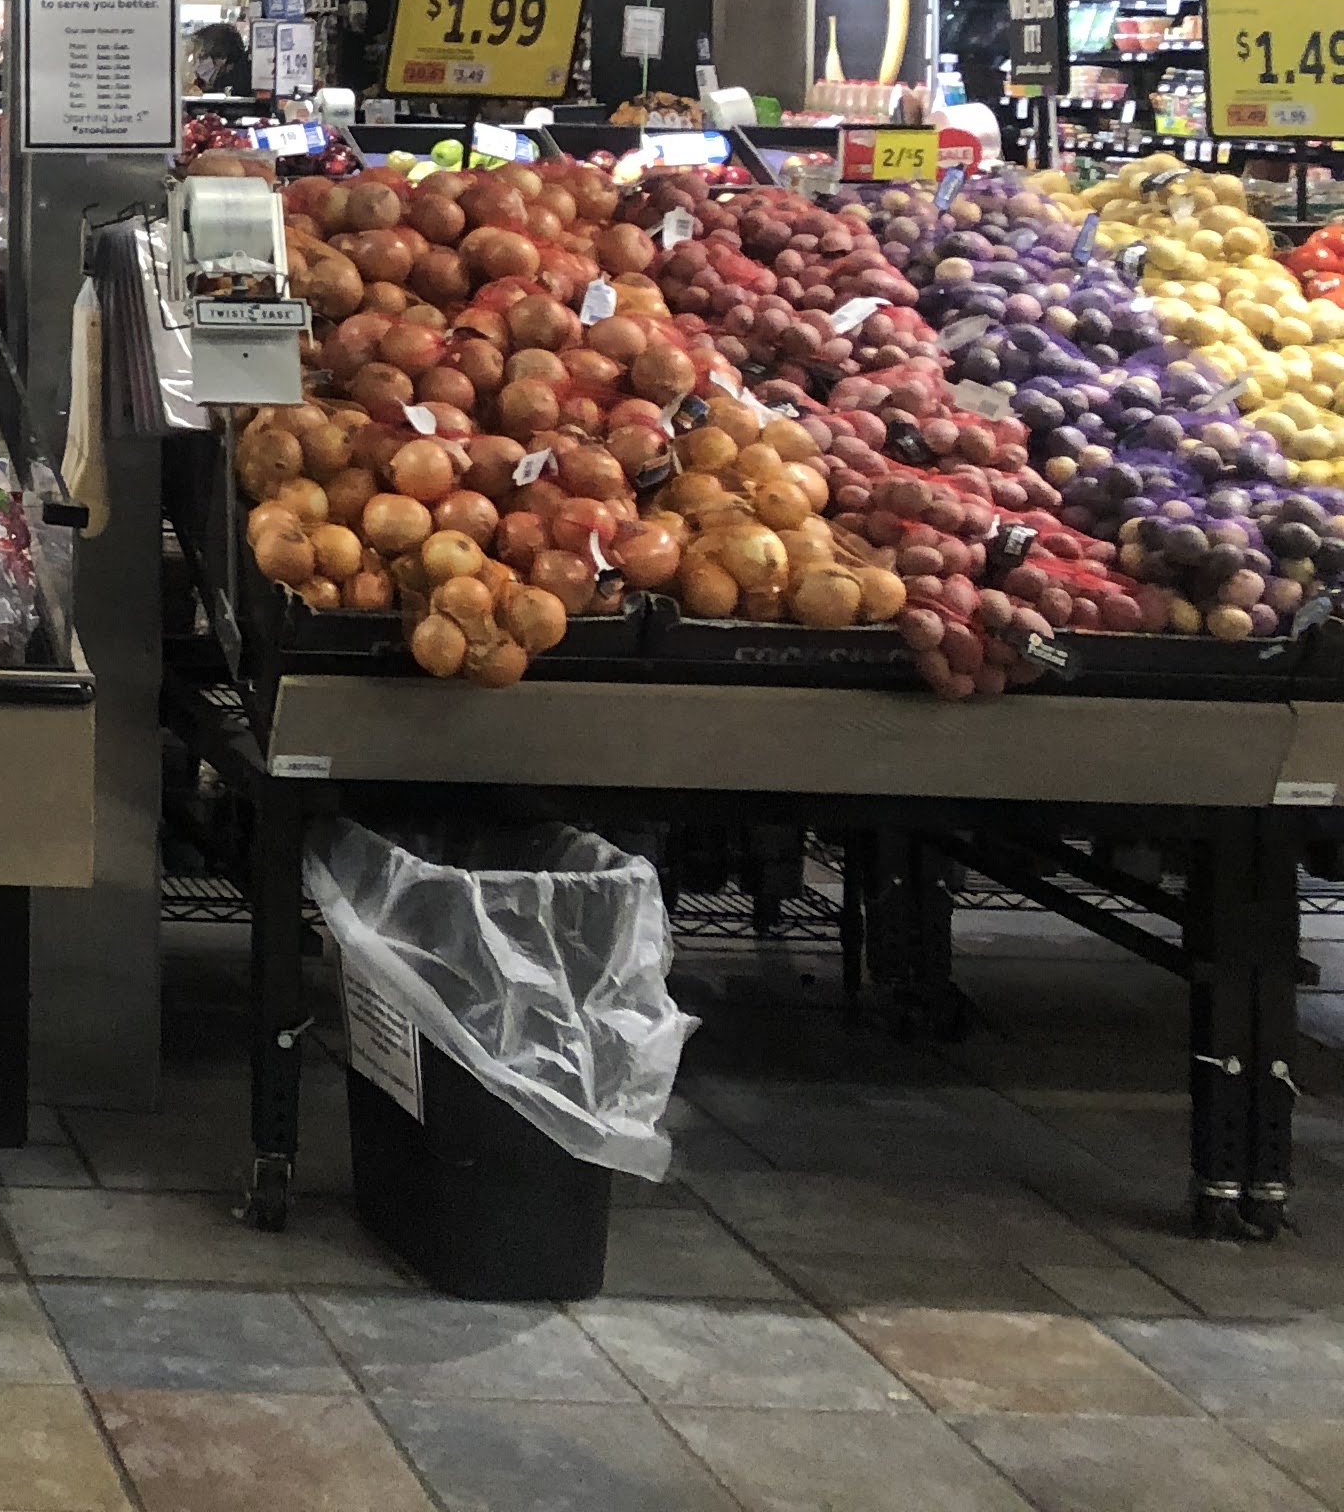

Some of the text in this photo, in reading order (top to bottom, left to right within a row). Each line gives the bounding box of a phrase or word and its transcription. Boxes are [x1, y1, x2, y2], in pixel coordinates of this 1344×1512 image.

[41, 0, 160, 12] to serve you better.
